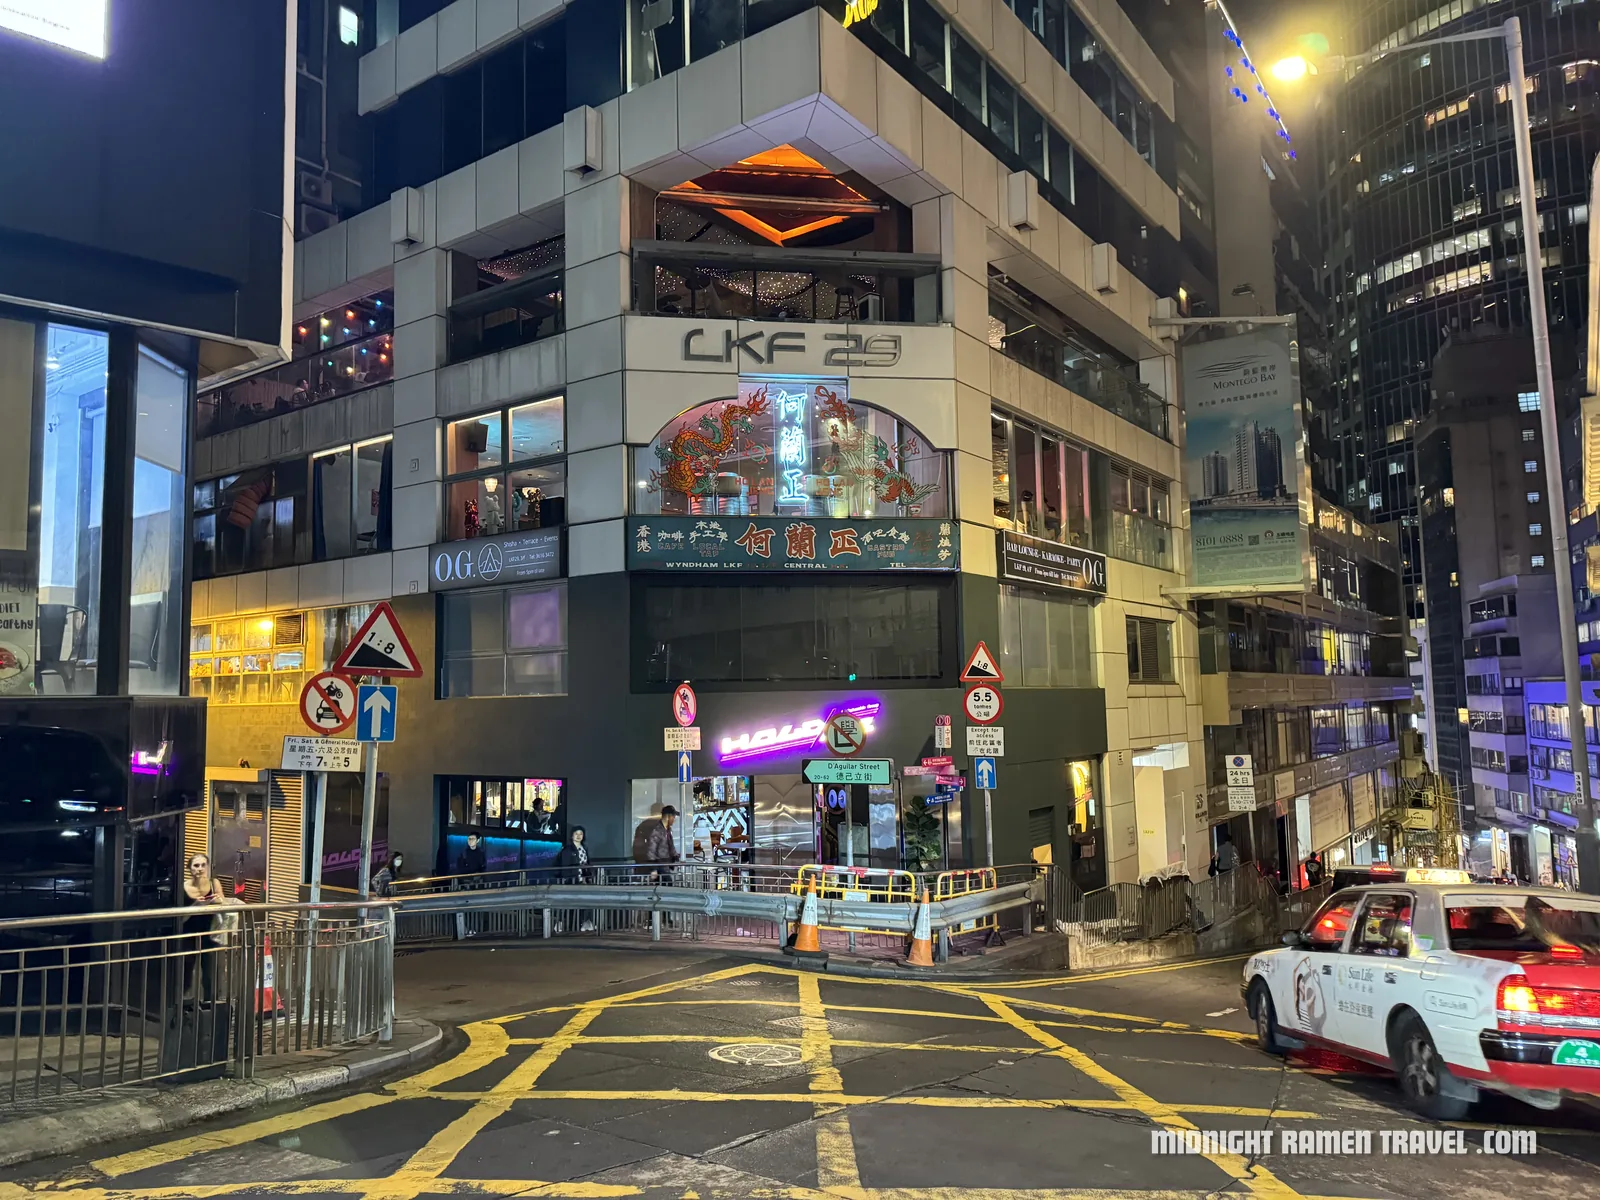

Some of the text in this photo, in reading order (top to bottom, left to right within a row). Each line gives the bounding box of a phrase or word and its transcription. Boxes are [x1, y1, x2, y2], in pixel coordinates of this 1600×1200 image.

[683, 328, 902, 368] LKF 29
[1213, 373, 1277, 390] MONTEGO BAY
[695, 520, 723, 531] 本地
[635, 524, 652, 553] 香港
[657, 530, 685, 542] 咖啡
[734, 522, 862, 560] 何蘭正
[937, 522, 952, 561] 蘭桂芳
[1196, 533, 1244, 547] 8101 0888
[657, 542, 685, 550] CAFE
[1006, 541, 1018, 553] BAR
[1066, 556, 1081, 568] PARTY
[435, 550, 476, 582] O.G.
[1083, 557, 1106, 587] O.G.
[368, 631, 396, 655] 1:8
[977, 660, 989, 670] 1:8
[973, 692, 992, 702] 5.5
[316, 756, 323, 767] 7
[343, 757, 350, 768] 5
[828, 762, 858, 771] D'Aguilar
[836, 772, 873, 781] 德己立街
[1348, 966, 1374, 982] Sun Life
[1575, 1046, 1588, 1058] 4
